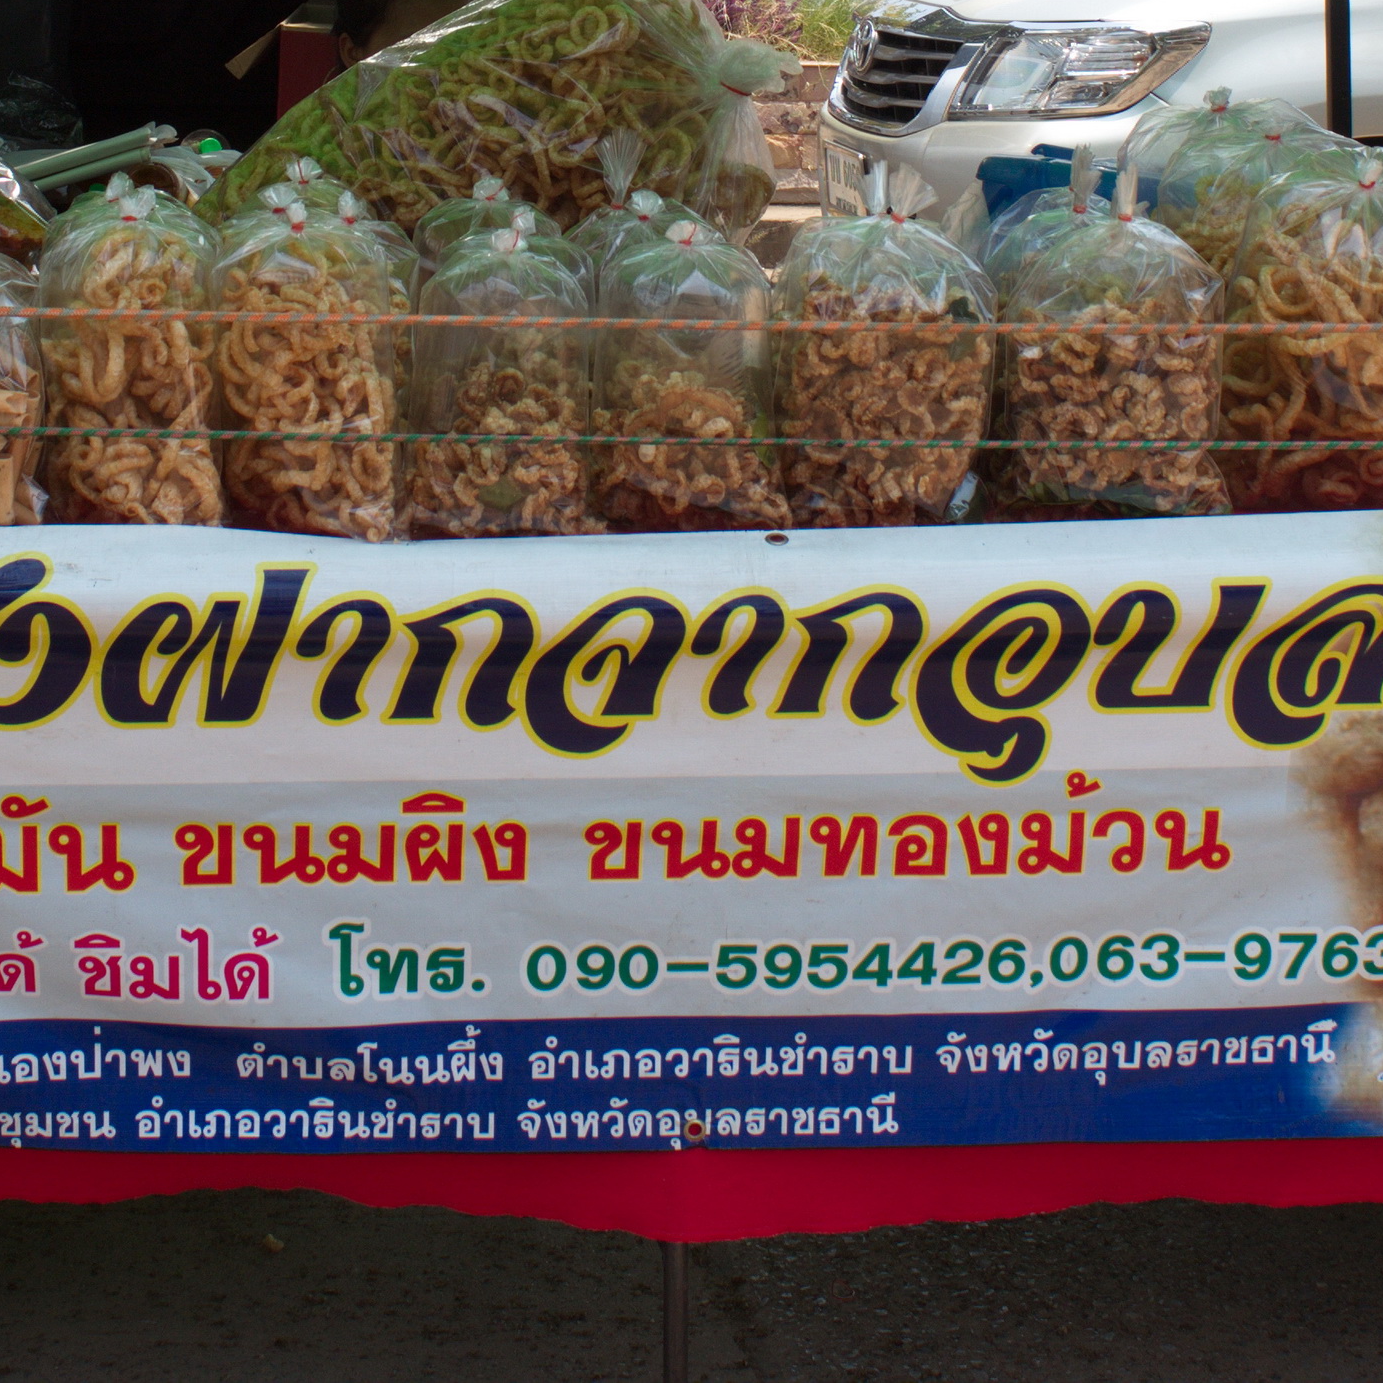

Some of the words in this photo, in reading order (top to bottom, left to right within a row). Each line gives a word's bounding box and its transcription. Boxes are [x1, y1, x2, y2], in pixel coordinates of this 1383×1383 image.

[175, 792, 528, 884] ขนมผิง
[584, 771, 1231, 882] ขนมทองม้วน
[73, 926, 279, 1001] ชิมได้
[328, 921, 486, 998] โทร.
[236, 1024, 504, 1084] ตำบลโนนผึ้ง
[527, 1031, 913, 1081] อำเภอวารินชำราบ
[935, 1018, 1339, 1085] จังหวัดอุบลราชธานี
[134, 1096, 496, 1141] อำเภอวารินชำราบ
